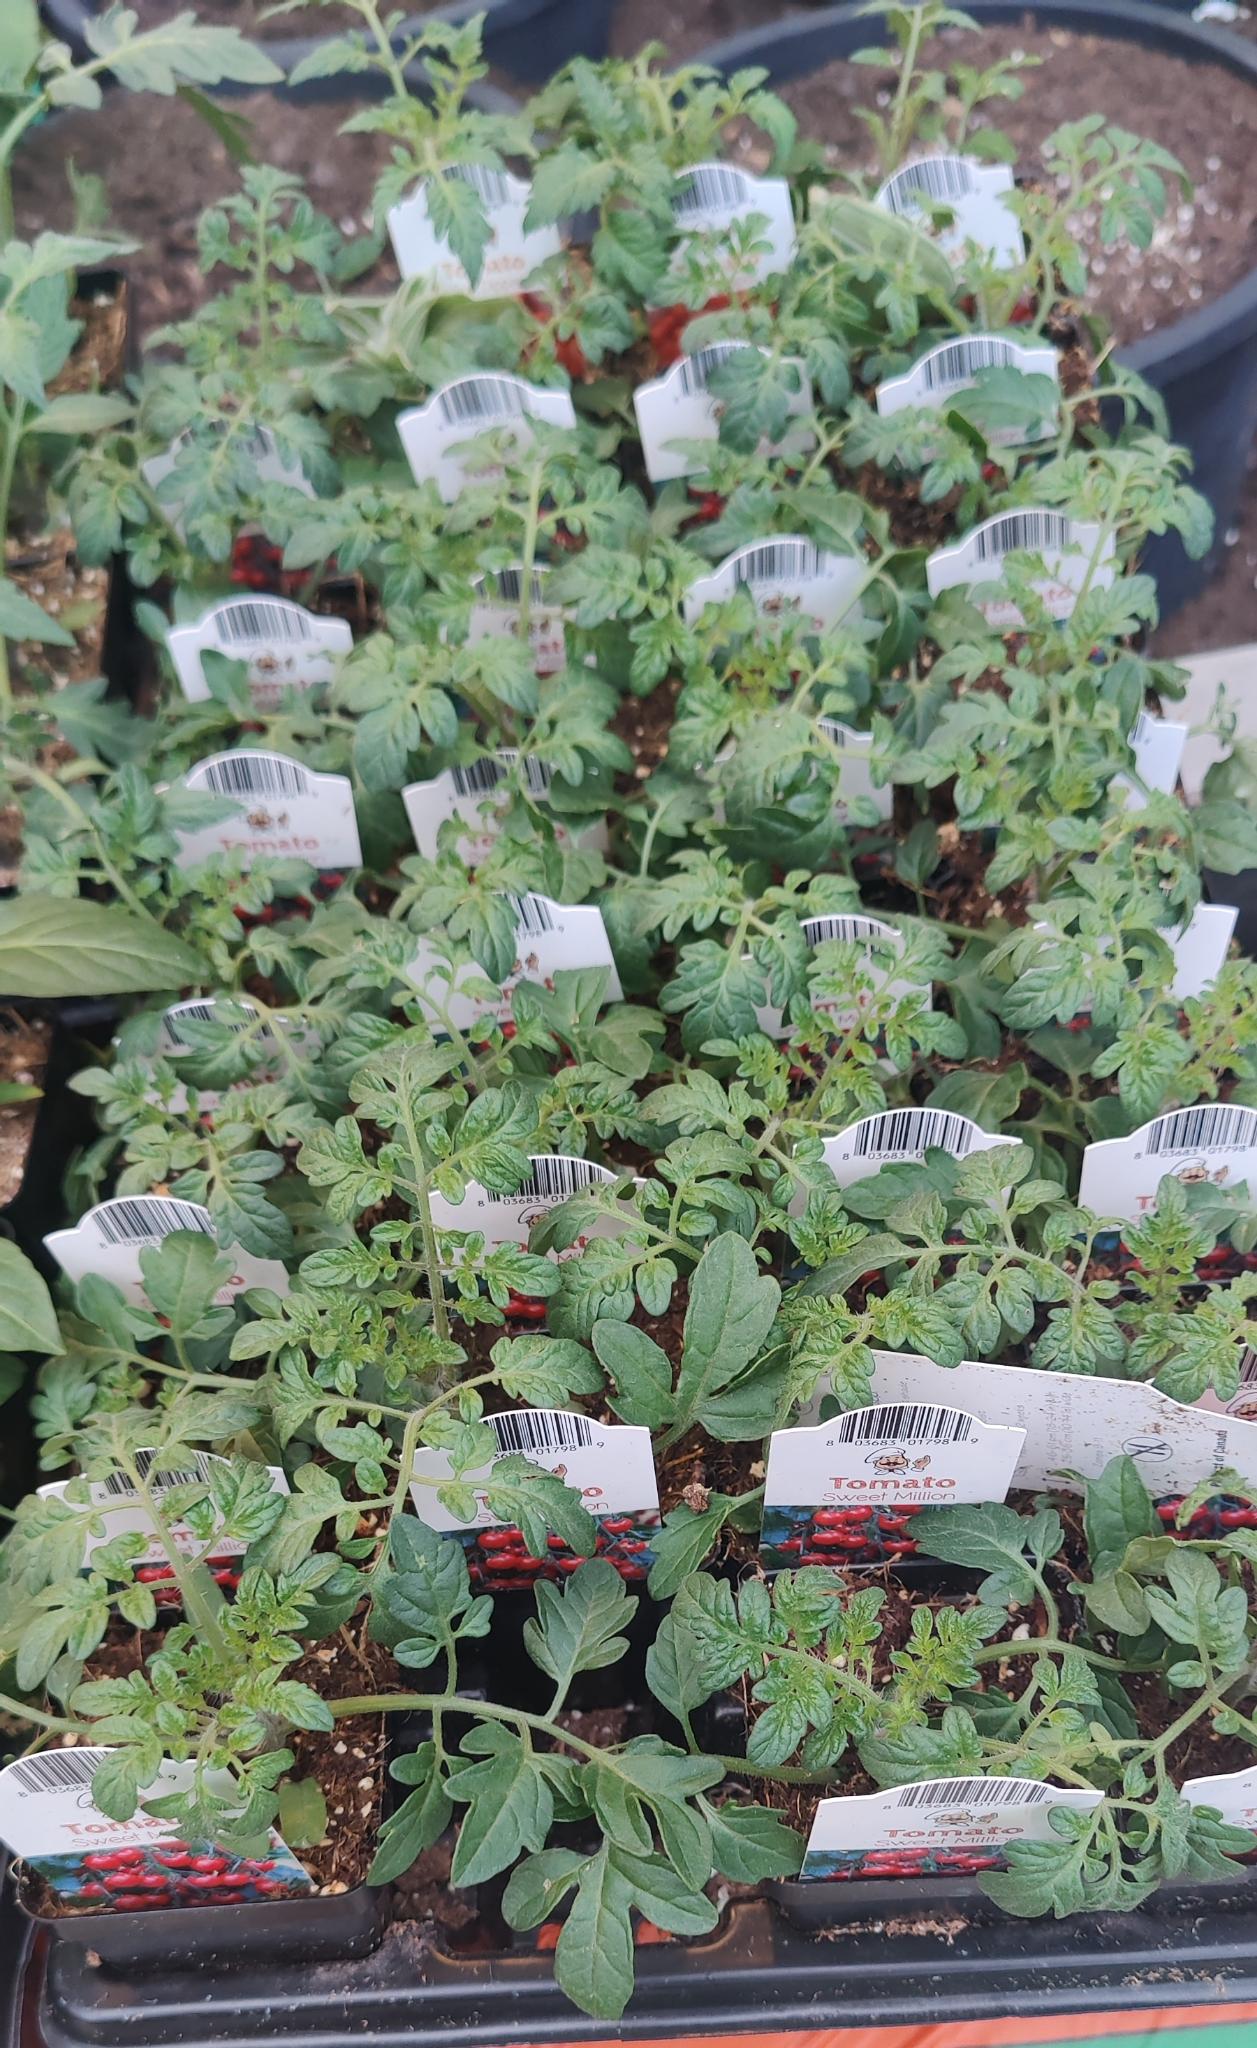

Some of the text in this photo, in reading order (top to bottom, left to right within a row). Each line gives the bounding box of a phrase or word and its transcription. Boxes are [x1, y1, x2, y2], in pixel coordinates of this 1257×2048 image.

[867, 1152, 905, 1160] 03683
[1159, 1149, 1198, 1158] 03683
[503, 1197, 541, 1205] 03683
[826, 1437, 979, 1447] 8 03683 01798 9
[536, 1444, 577, 1456] 01798
[596, 1441, 605, 1449] 9
[829, 1476, 956, 1490] Tomato
[822, 1491, 956, 1502] Sweet Million
[883, 1826, 1025, 1838] Tomato
[72, 1833, 141, 1848] Sweet
[874, 1838, 945, 1847] Sweet
